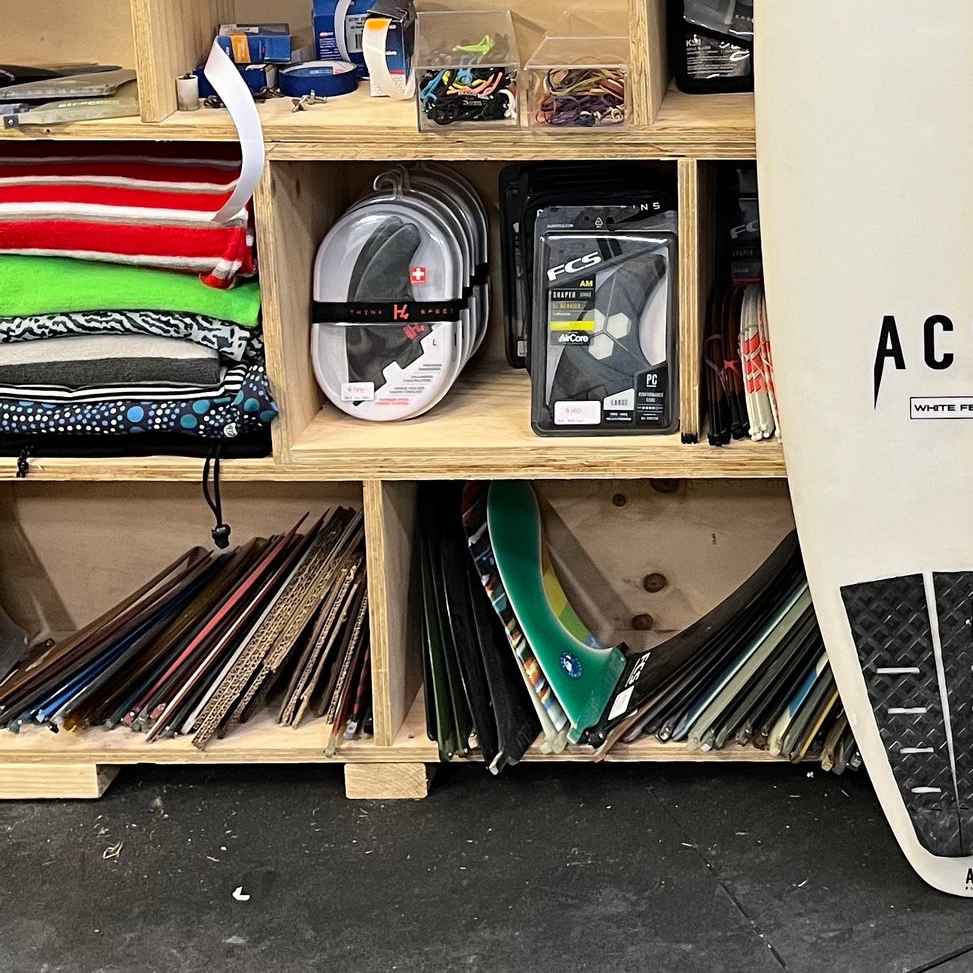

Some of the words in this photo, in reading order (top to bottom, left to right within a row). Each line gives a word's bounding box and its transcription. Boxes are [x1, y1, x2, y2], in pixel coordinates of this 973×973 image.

[547, 251, 602, 282] FCS
[579, 280, 594, 288] AM
[558, 332, 590, 343] AirCore
[646, 373, 658, 386] PC
[914, 403, 956, 412] WHITE
